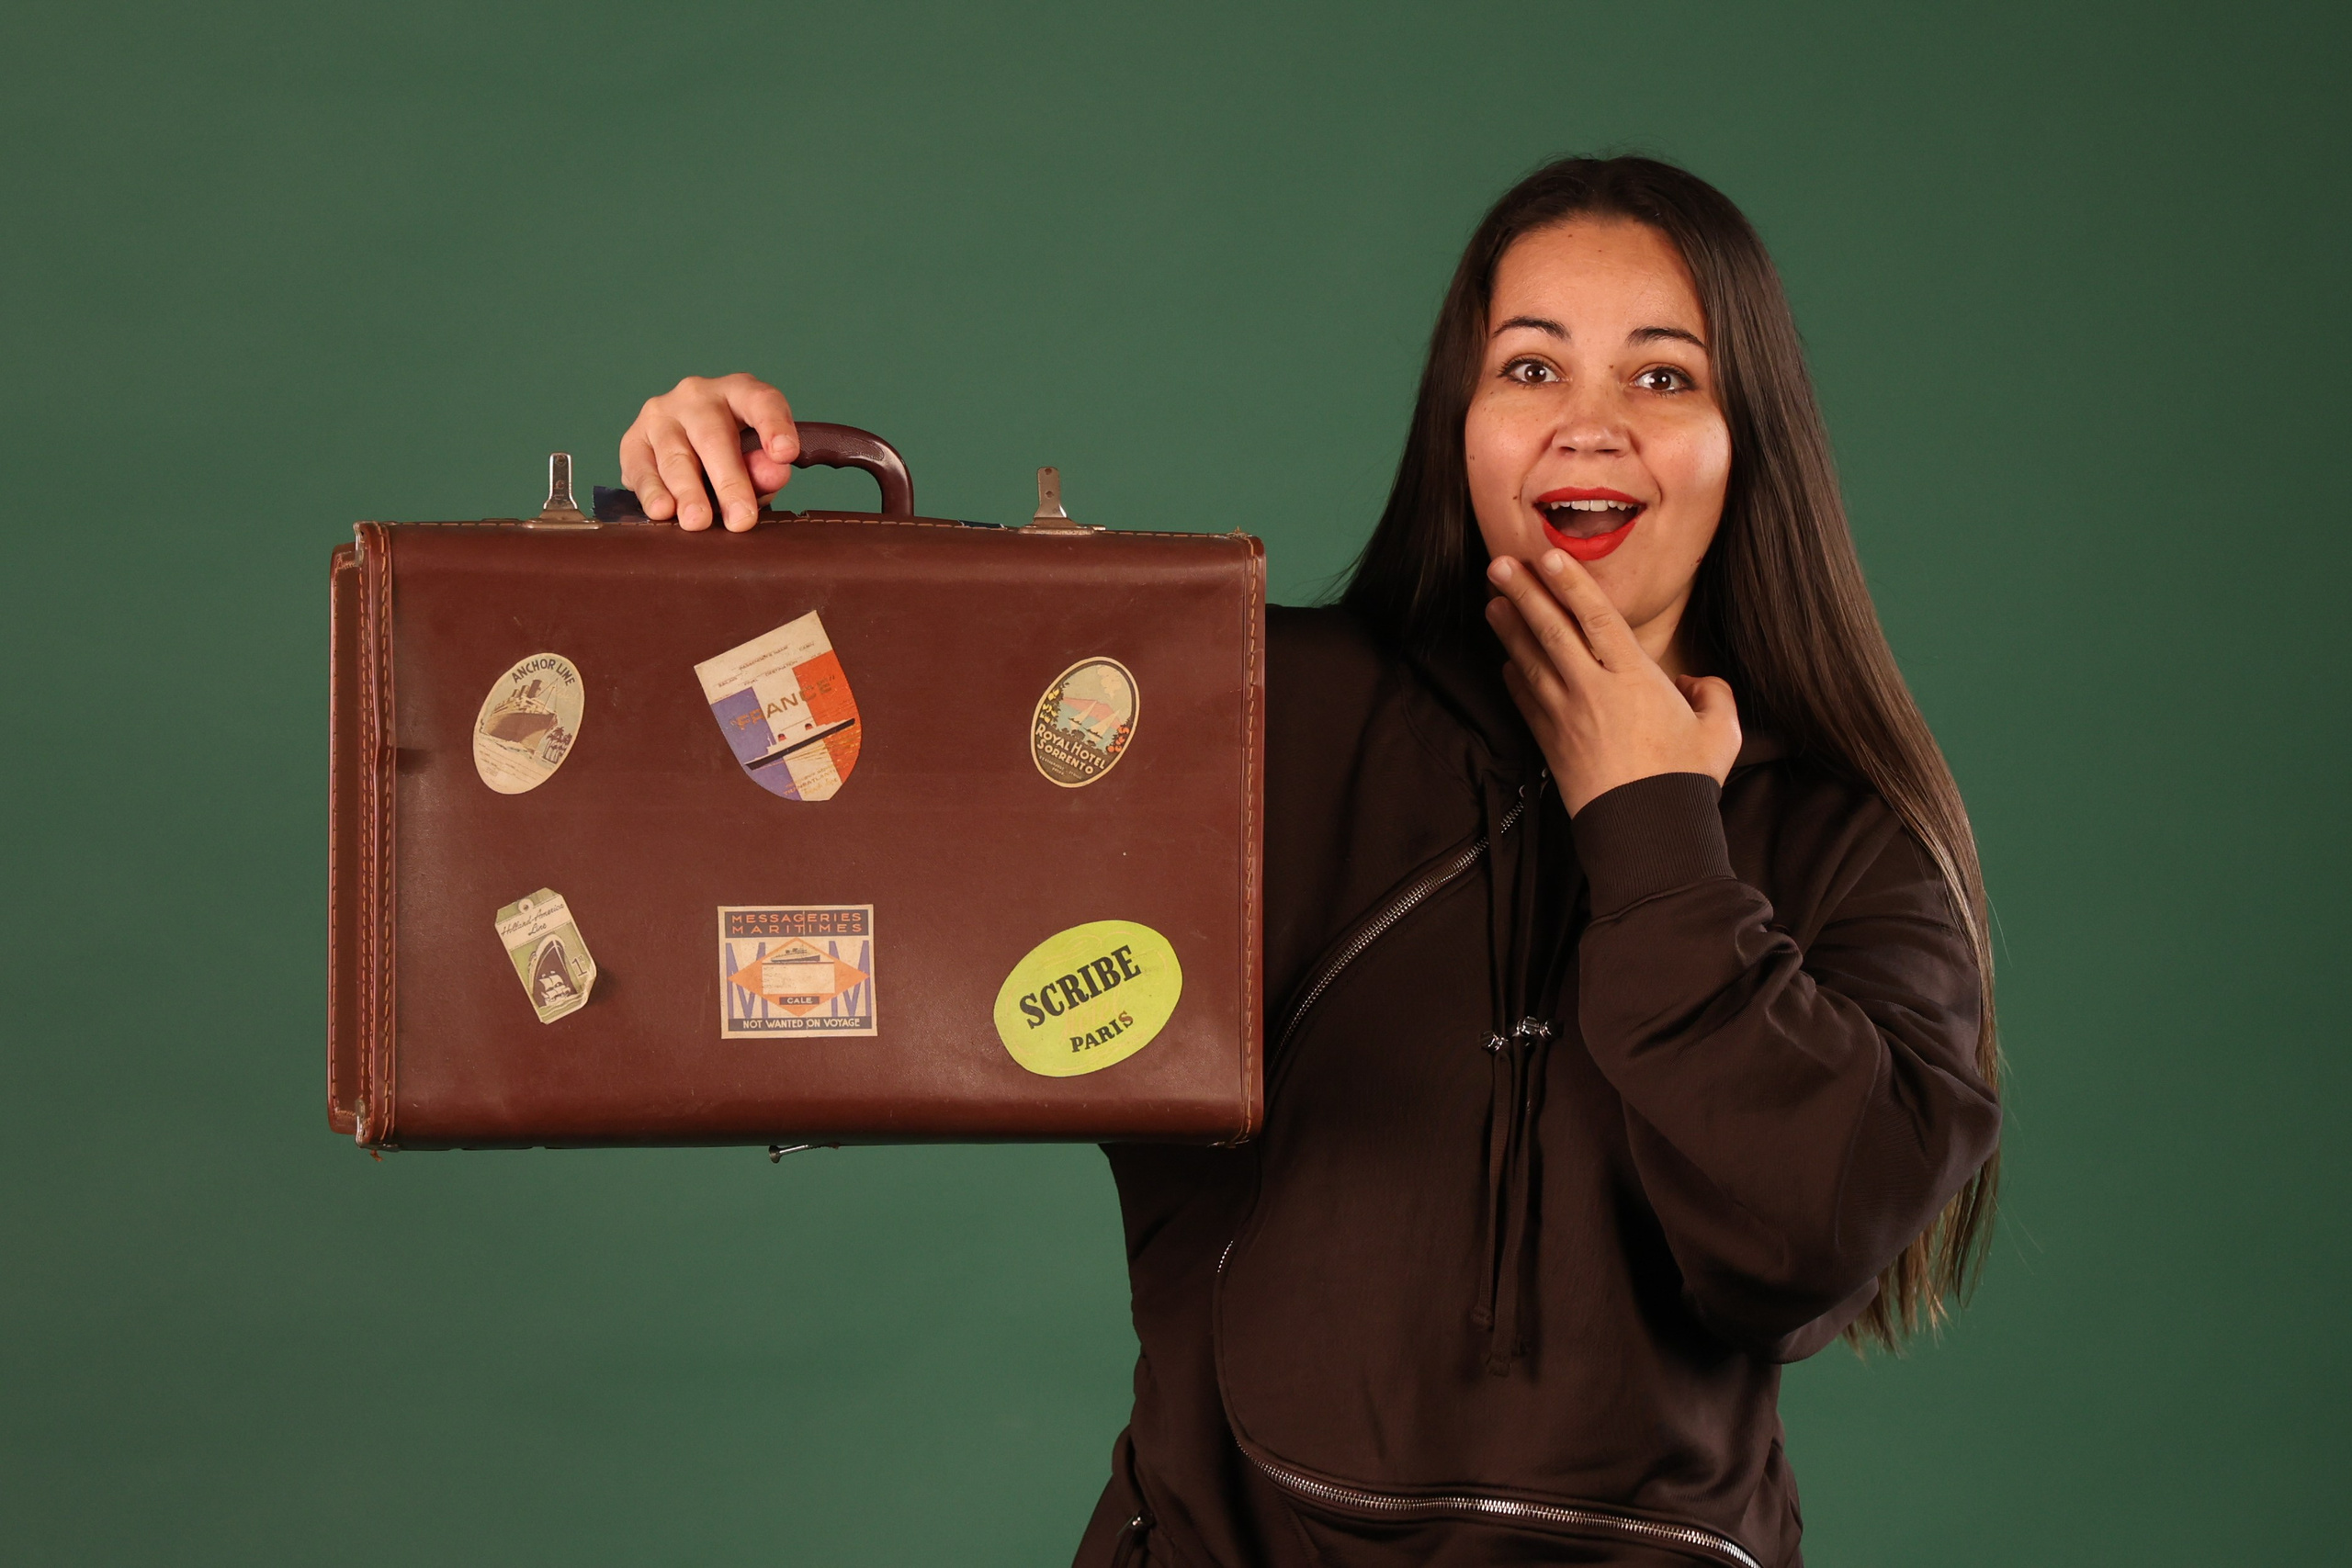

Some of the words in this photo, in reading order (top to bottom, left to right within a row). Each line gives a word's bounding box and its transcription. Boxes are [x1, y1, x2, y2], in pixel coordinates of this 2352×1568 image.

[512, 659, 556, 683] ANCHOR
[556, 663, 576, 686] LINE
[1035, 723, 1070, 751] ROYAL
[1070, 741, 1106, 770] HOTEL
[1036, 739, 1094, 774] SORRENTO
[731, 912, 862, 924] MESSAGERIES
[731, 923, 863, 934] MARITIMES
[527, 922, 548, 937] Line
[1019, 944, 1142, 1030] SCRIBE
[786, 997, 813, 1005] CALE
[742, 1020, 763, 1029] NOT
[765, 1019, 804, 1029] WANTED
[806, 1019, 820, 1028] ON
[822, 1018, 861, 1028] VOYAGE
[1069, 1010, 1134, 1053] PARIS
